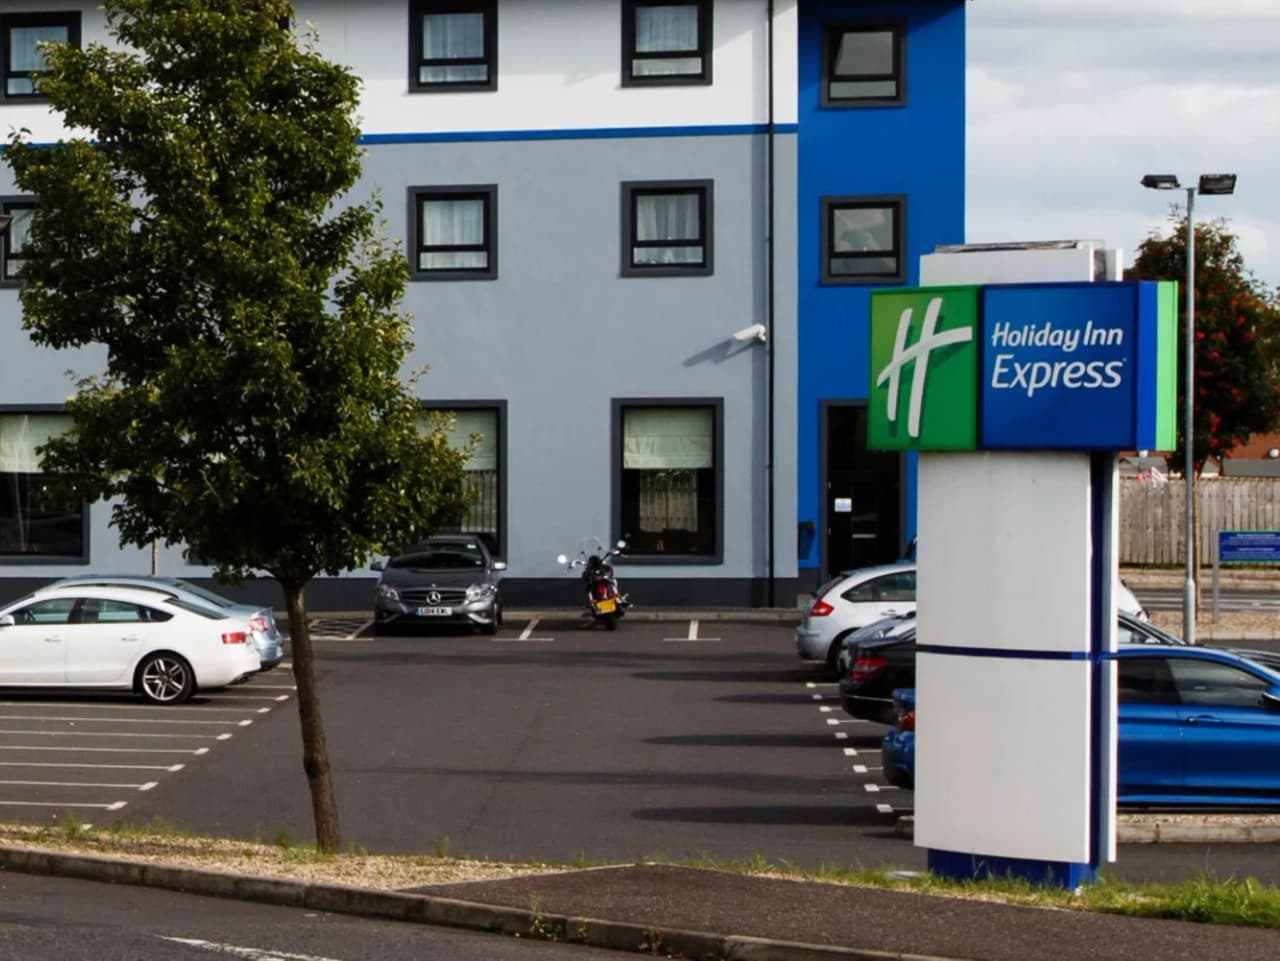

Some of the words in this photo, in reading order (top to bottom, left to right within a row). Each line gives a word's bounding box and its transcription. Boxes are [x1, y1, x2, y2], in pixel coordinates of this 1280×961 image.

[991, 321, 1081, 352] Holiday
[1083, 320, 1124, 346] Inn
[877, 297, 973, 438] H
[991, 354, 1124, 398] Express
